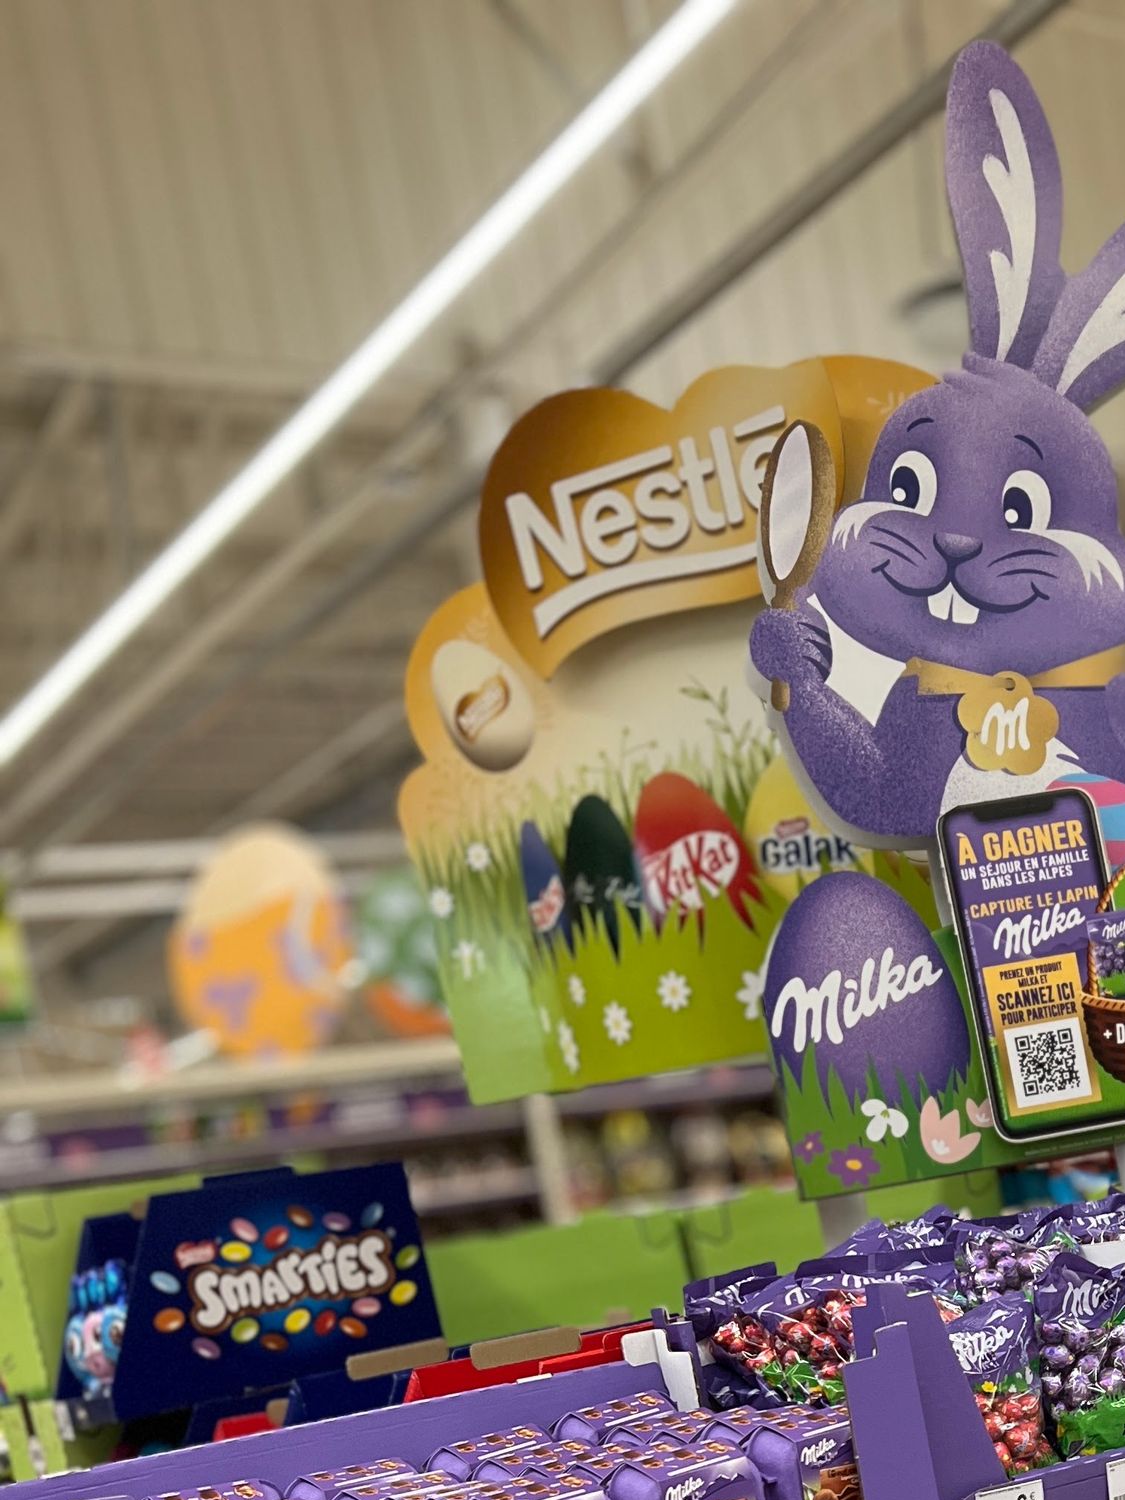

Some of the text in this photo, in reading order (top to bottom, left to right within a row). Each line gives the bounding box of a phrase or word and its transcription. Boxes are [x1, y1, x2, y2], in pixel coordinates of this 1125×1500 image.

[761, 836, 857, 868] Galak
[956, 820, 1086, 865] À GAGNER
[961, 850, 1089, 880] UN SÉJOUR EN FAMILLE
[982, 865, 1073, 890] DANS LES ALPES
[970, 885, 1098, 919] CAPTURE LE LAPIN
[993, 904, 1085, 958] Milka
[999, 968, 1024, 980] PRENEZ
[1035, 961, 1062, 974] PRODUIT
[1018, 974, 1048, 987] MILKA ET
[772, 947, 943, 1052] Milka
[997, 982, 1075, 1011] SCANNEZ ICI
[1001, 1001, 1077, 1025] POUR PARTICIPER
[802, 1438, 836, 1465] Milka
